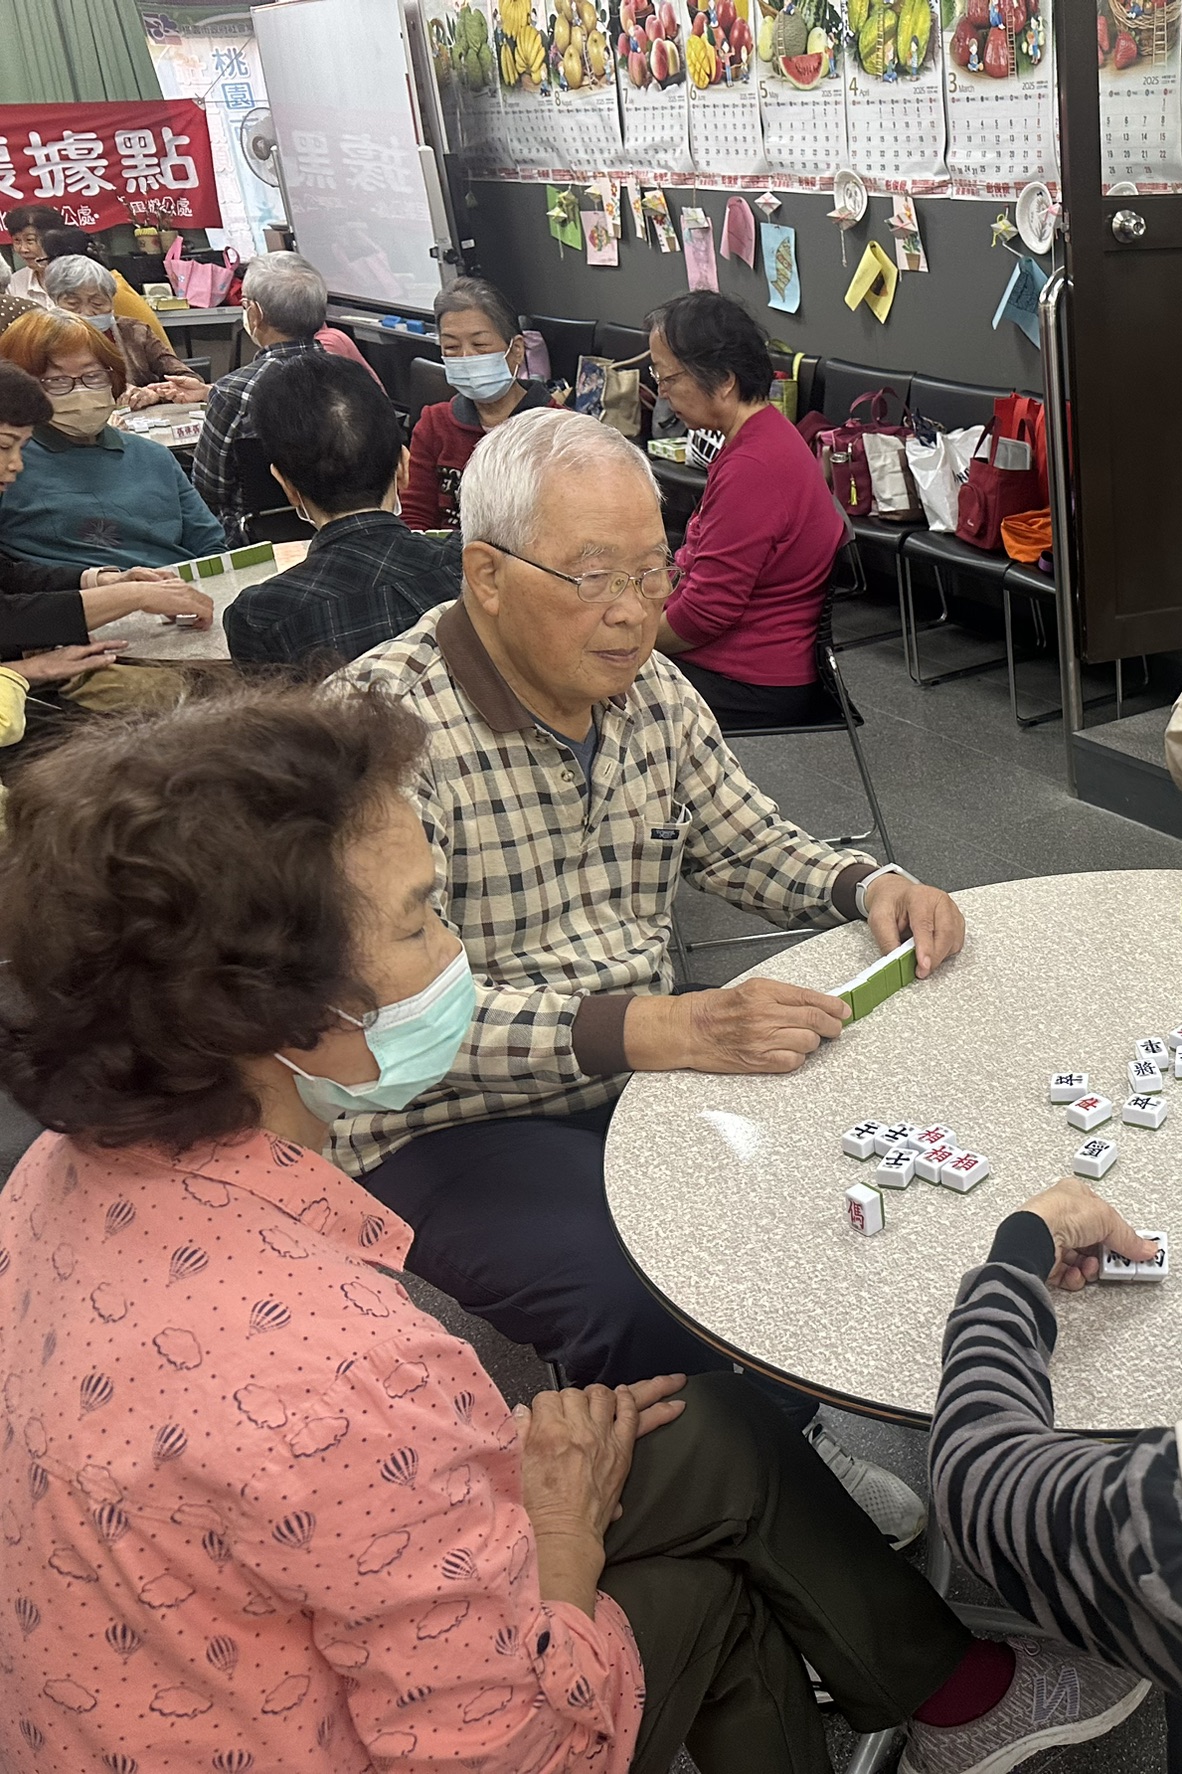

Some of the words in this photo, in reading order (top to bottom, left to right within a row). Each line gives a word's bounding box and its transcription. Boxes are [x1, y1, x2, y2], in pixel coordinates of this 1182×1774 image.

[760, 81, 768, 98] 5
[849, 77, 858, 96] 4
[948, 72, 957, 93] 3
[959, 84, 975, 93] March
[1143, 76, 1159, 85] 2025
[0, 126, 199, 199] 據點
[1134, 1061, 1156, 1075] 將
